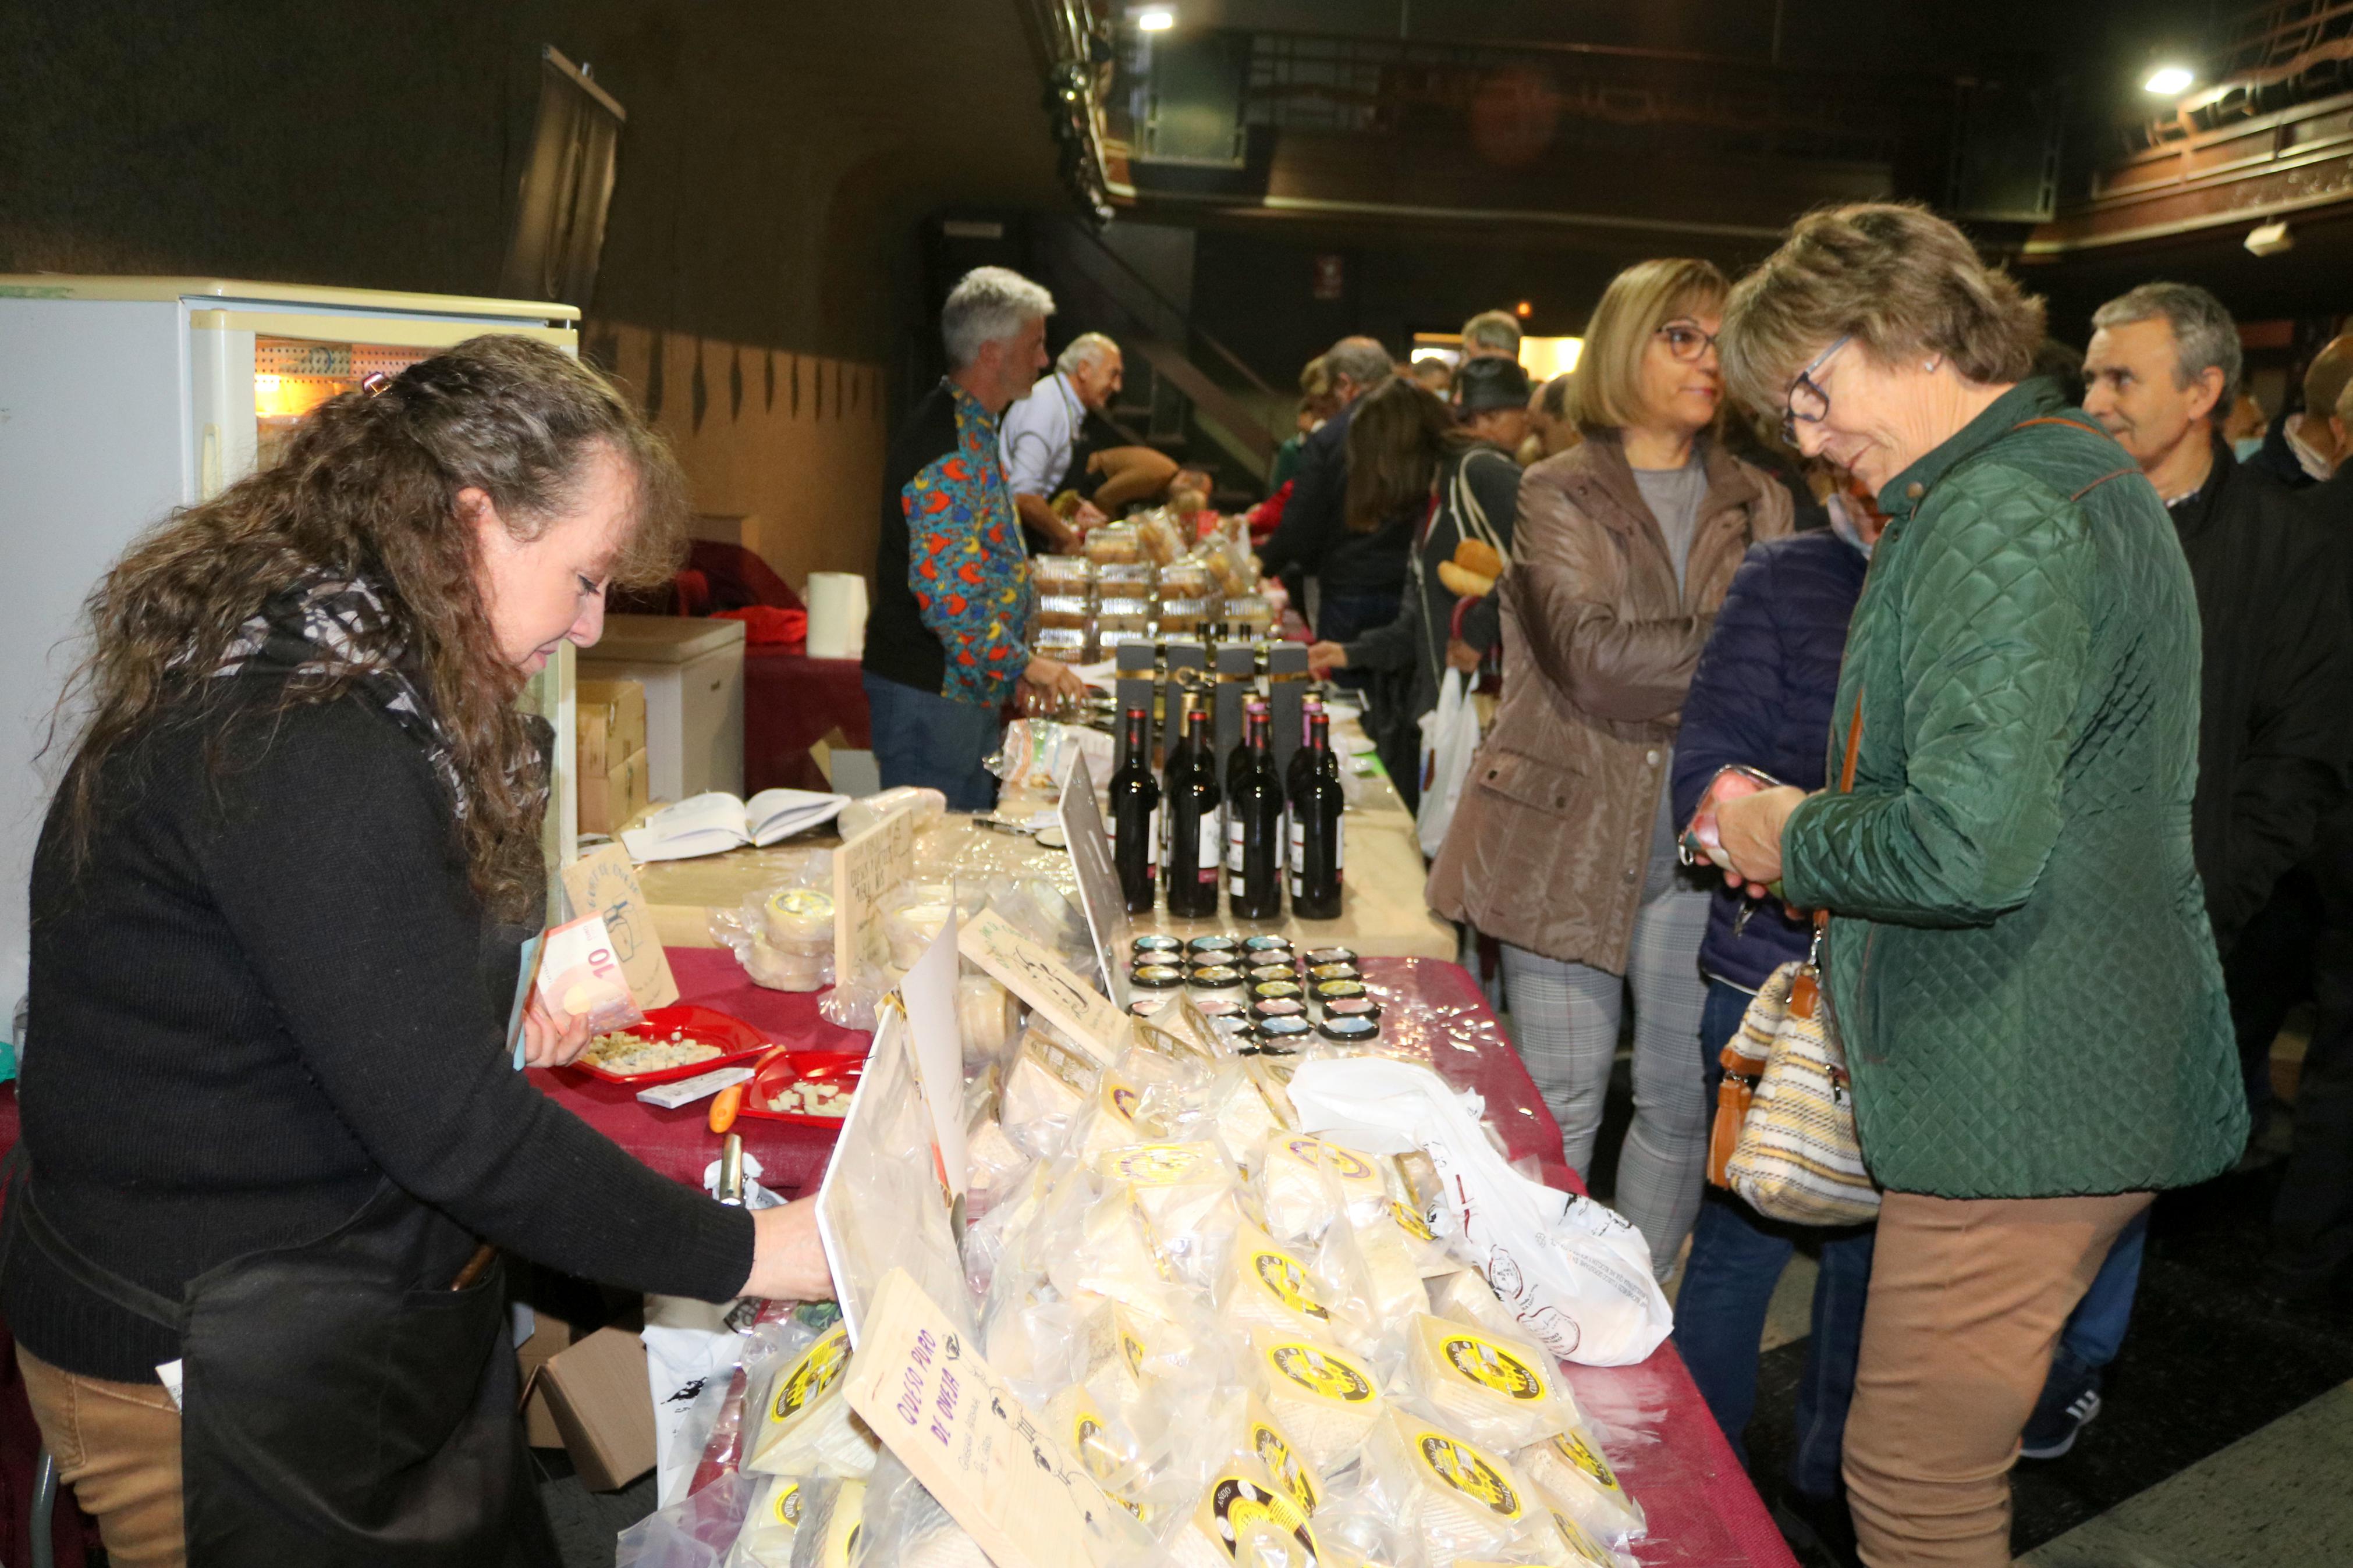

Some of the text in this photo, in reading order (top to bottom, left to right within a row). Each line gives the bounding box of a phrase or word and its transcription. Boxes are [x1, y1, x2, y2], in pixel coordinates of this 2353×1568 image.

[588, 948, 615, 979] 10
[897, 1329, 936, 1425] QUESO PURO
[931, 1367, 960, 1448] DE OVEJA
[784, 1492, 799, 1518] CURADO
[1218, 1487, 1231, 1509] AÑEJO
